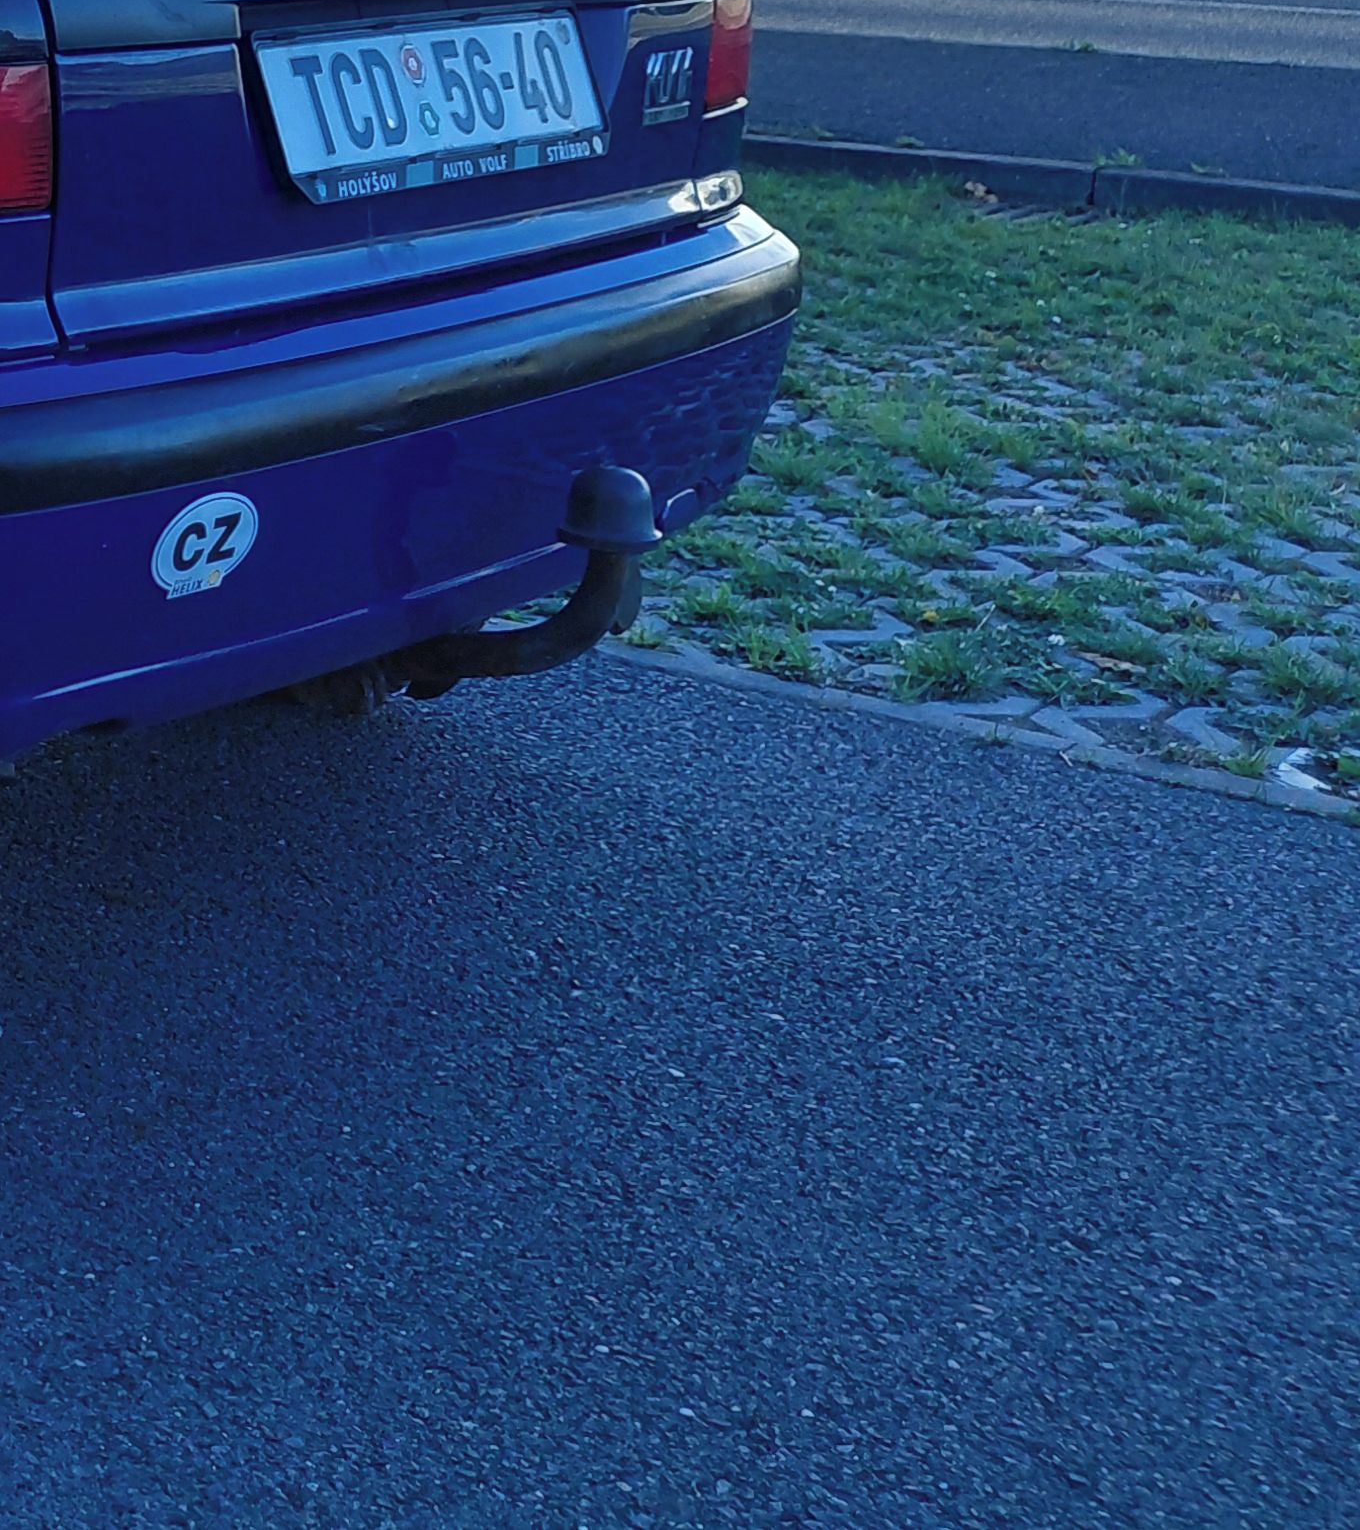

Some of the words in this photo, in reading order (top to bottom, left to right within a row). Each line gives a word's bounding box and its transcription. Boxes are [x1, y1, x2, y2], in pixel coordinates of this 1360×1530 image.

[289, 47, 408, 156] TCD
[431, 29, 573, 136] 56-40
[337, 171, 398, 198] HOLÝŠOV
[442, 160, 474, 180] AUTO
[479, 153, 509, 173] VOLF
[546, 140, 590, 163] STŘÍBRO
[172, 511, 242, 572] CZ
[171, 579, 203, 596] HELIX
